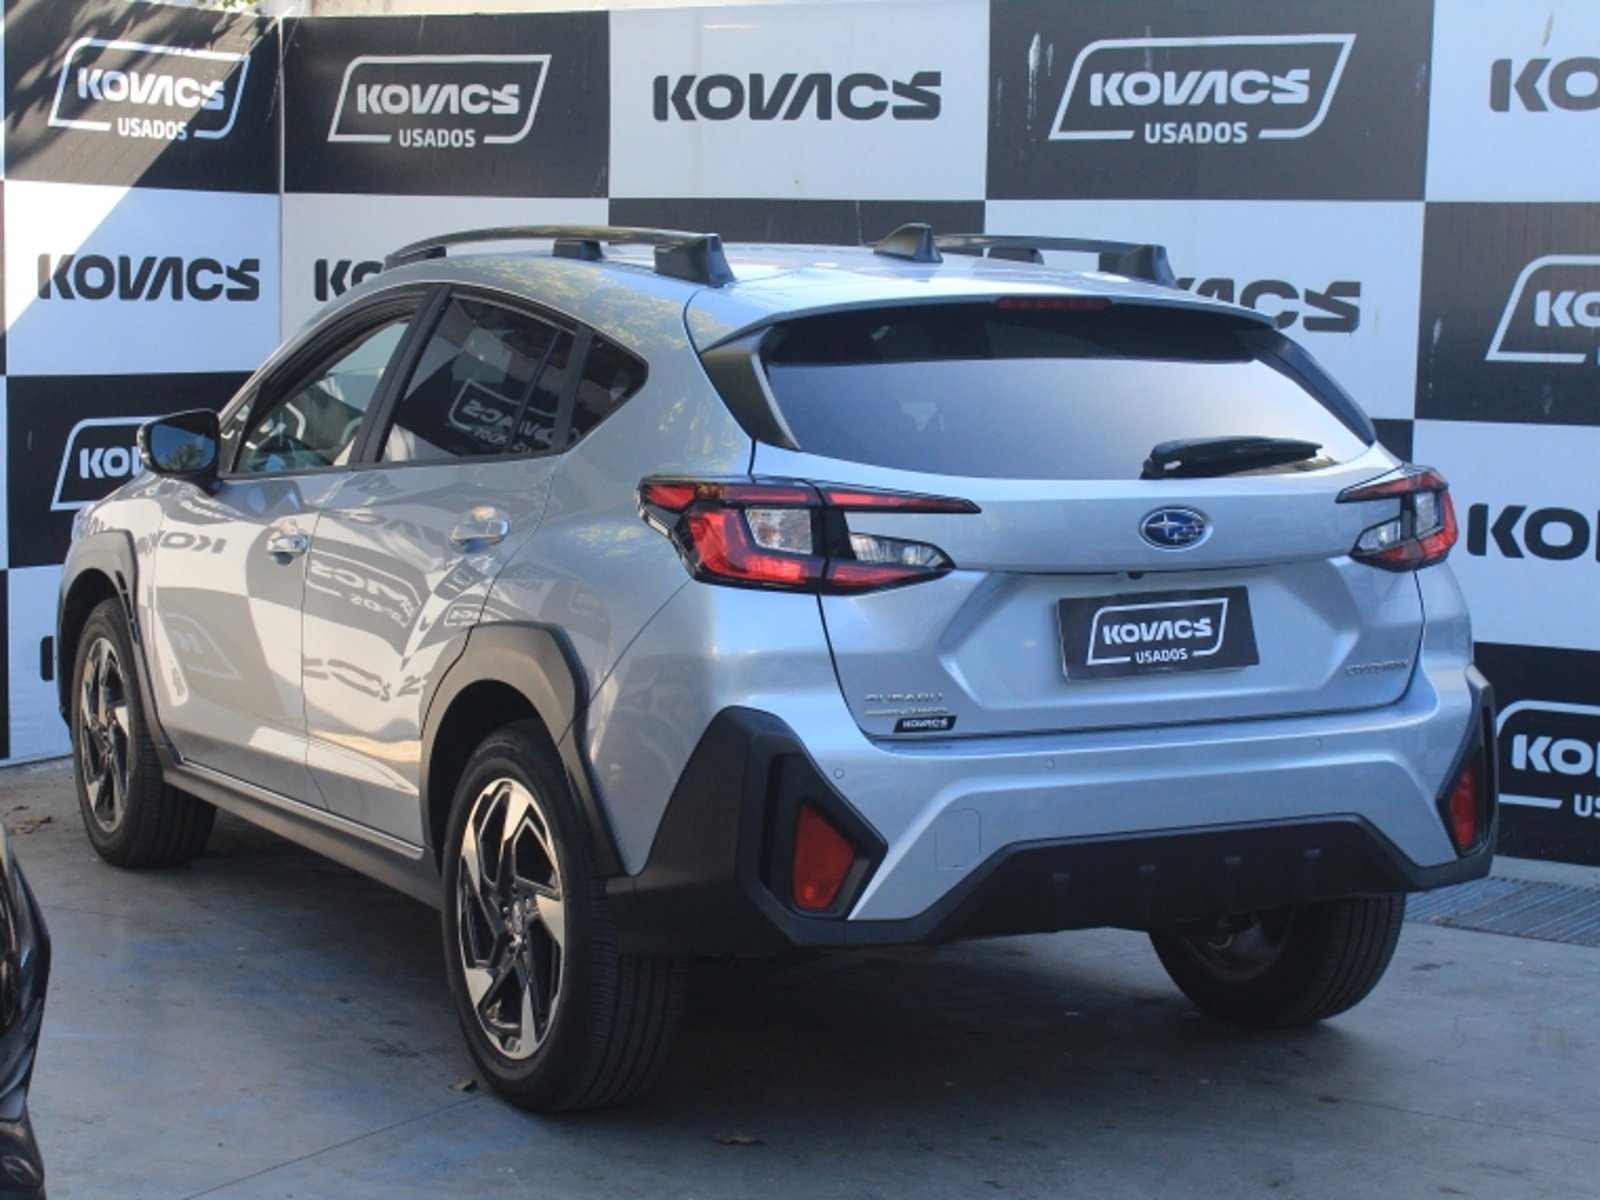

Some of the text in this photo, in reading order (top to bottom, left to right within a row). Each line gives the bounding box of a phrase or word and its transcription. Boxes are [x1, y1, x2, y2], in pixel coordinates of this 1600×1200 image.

[77, 67, 225, 110] KOVACS
[357, 84, 520, 114] KOVACS
[653, 71, 942, 121] KOVACS
[1090, 69, 1310, 106] KOVACS
[117, 117, 188, 140] USADOS
[398, 128, 477, 148] USADOS
[1144, 122, 1248, 144] USADOS
[37, 253, 260, 301] KOVACS
[1176, 276, 1362, 333] CS
[1467, 502, 1600, 563] KO
[1102, 616, 1213, 645] KOVACS
[1134, 647, 1188, 665] USADOS
[1512, 734, 1600, 777] KO
